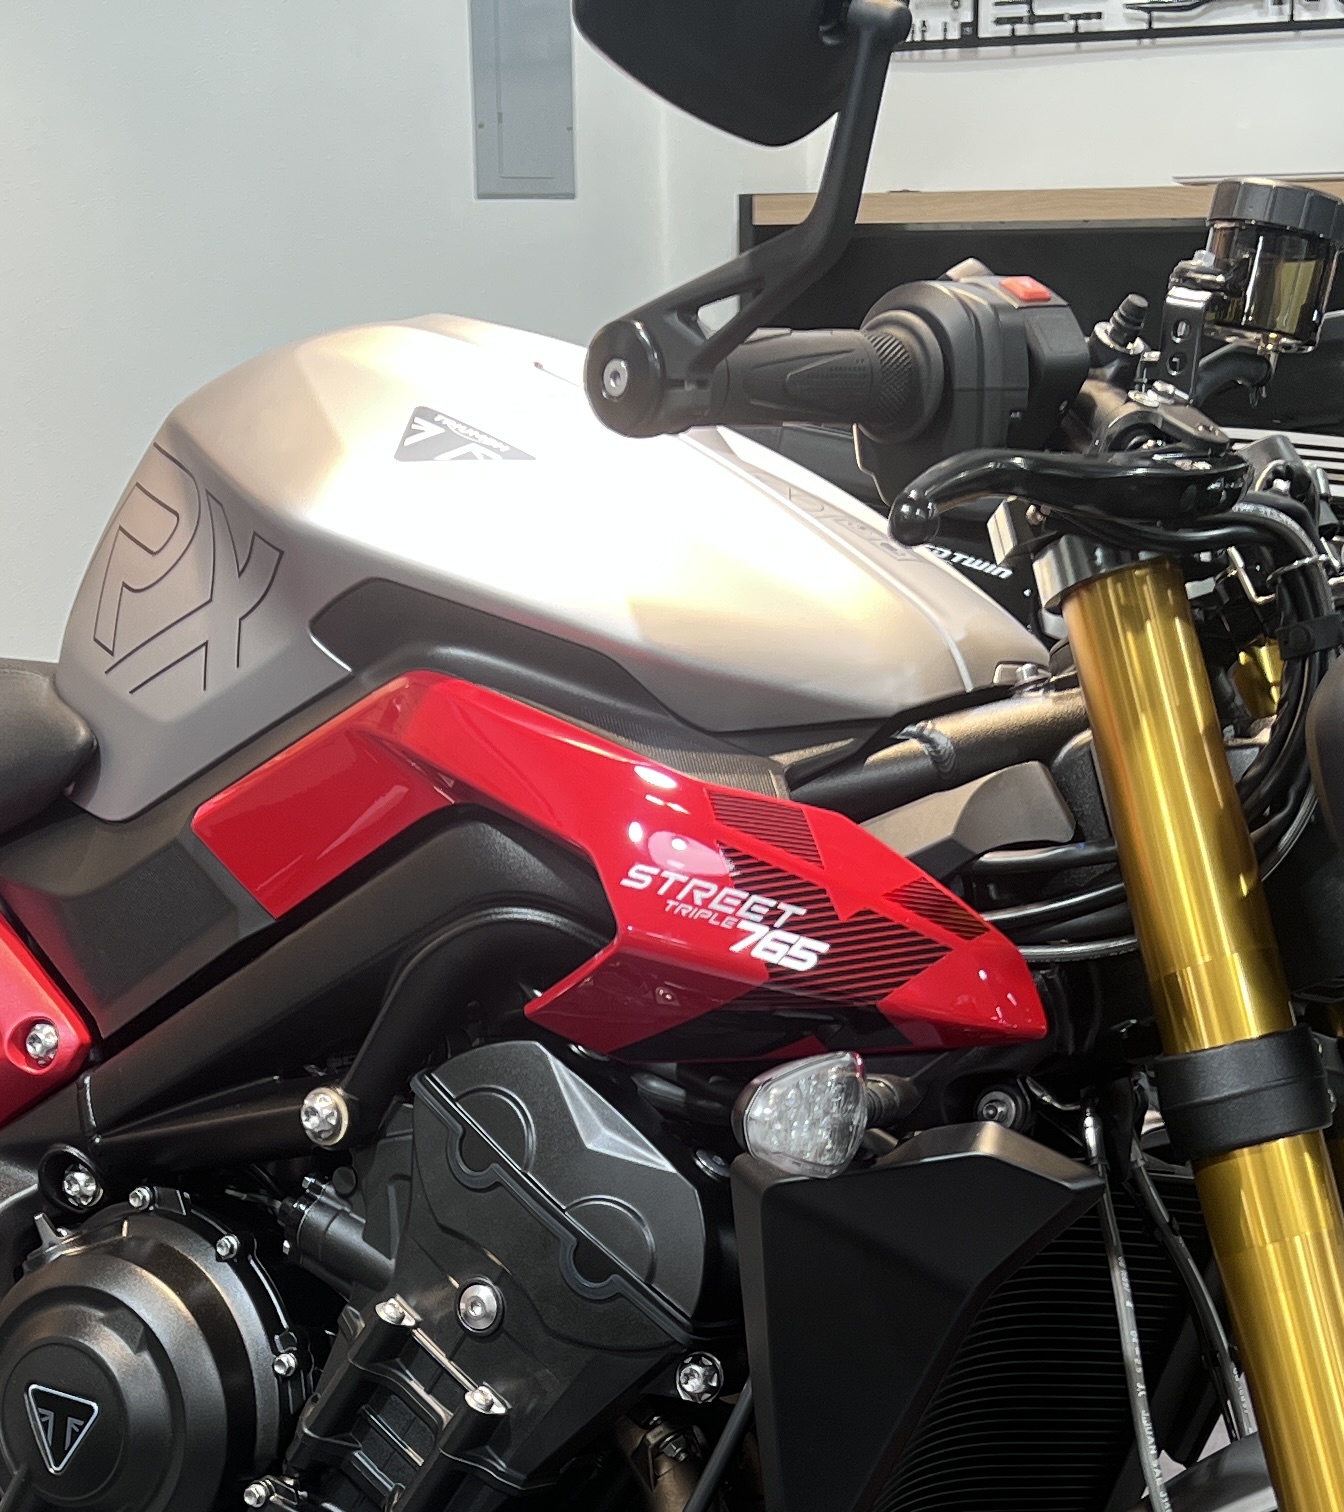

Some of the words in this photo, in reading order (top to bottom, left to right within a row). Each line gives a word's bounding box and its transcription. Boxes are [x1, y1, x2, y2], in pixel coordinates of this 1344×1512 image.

[953, 551, 1013, 579] TWIN
[620, 864, 807, 928] STREET
[664, 899, 738, 930] TRIPLE
[729, 921, 831, 972] 765
